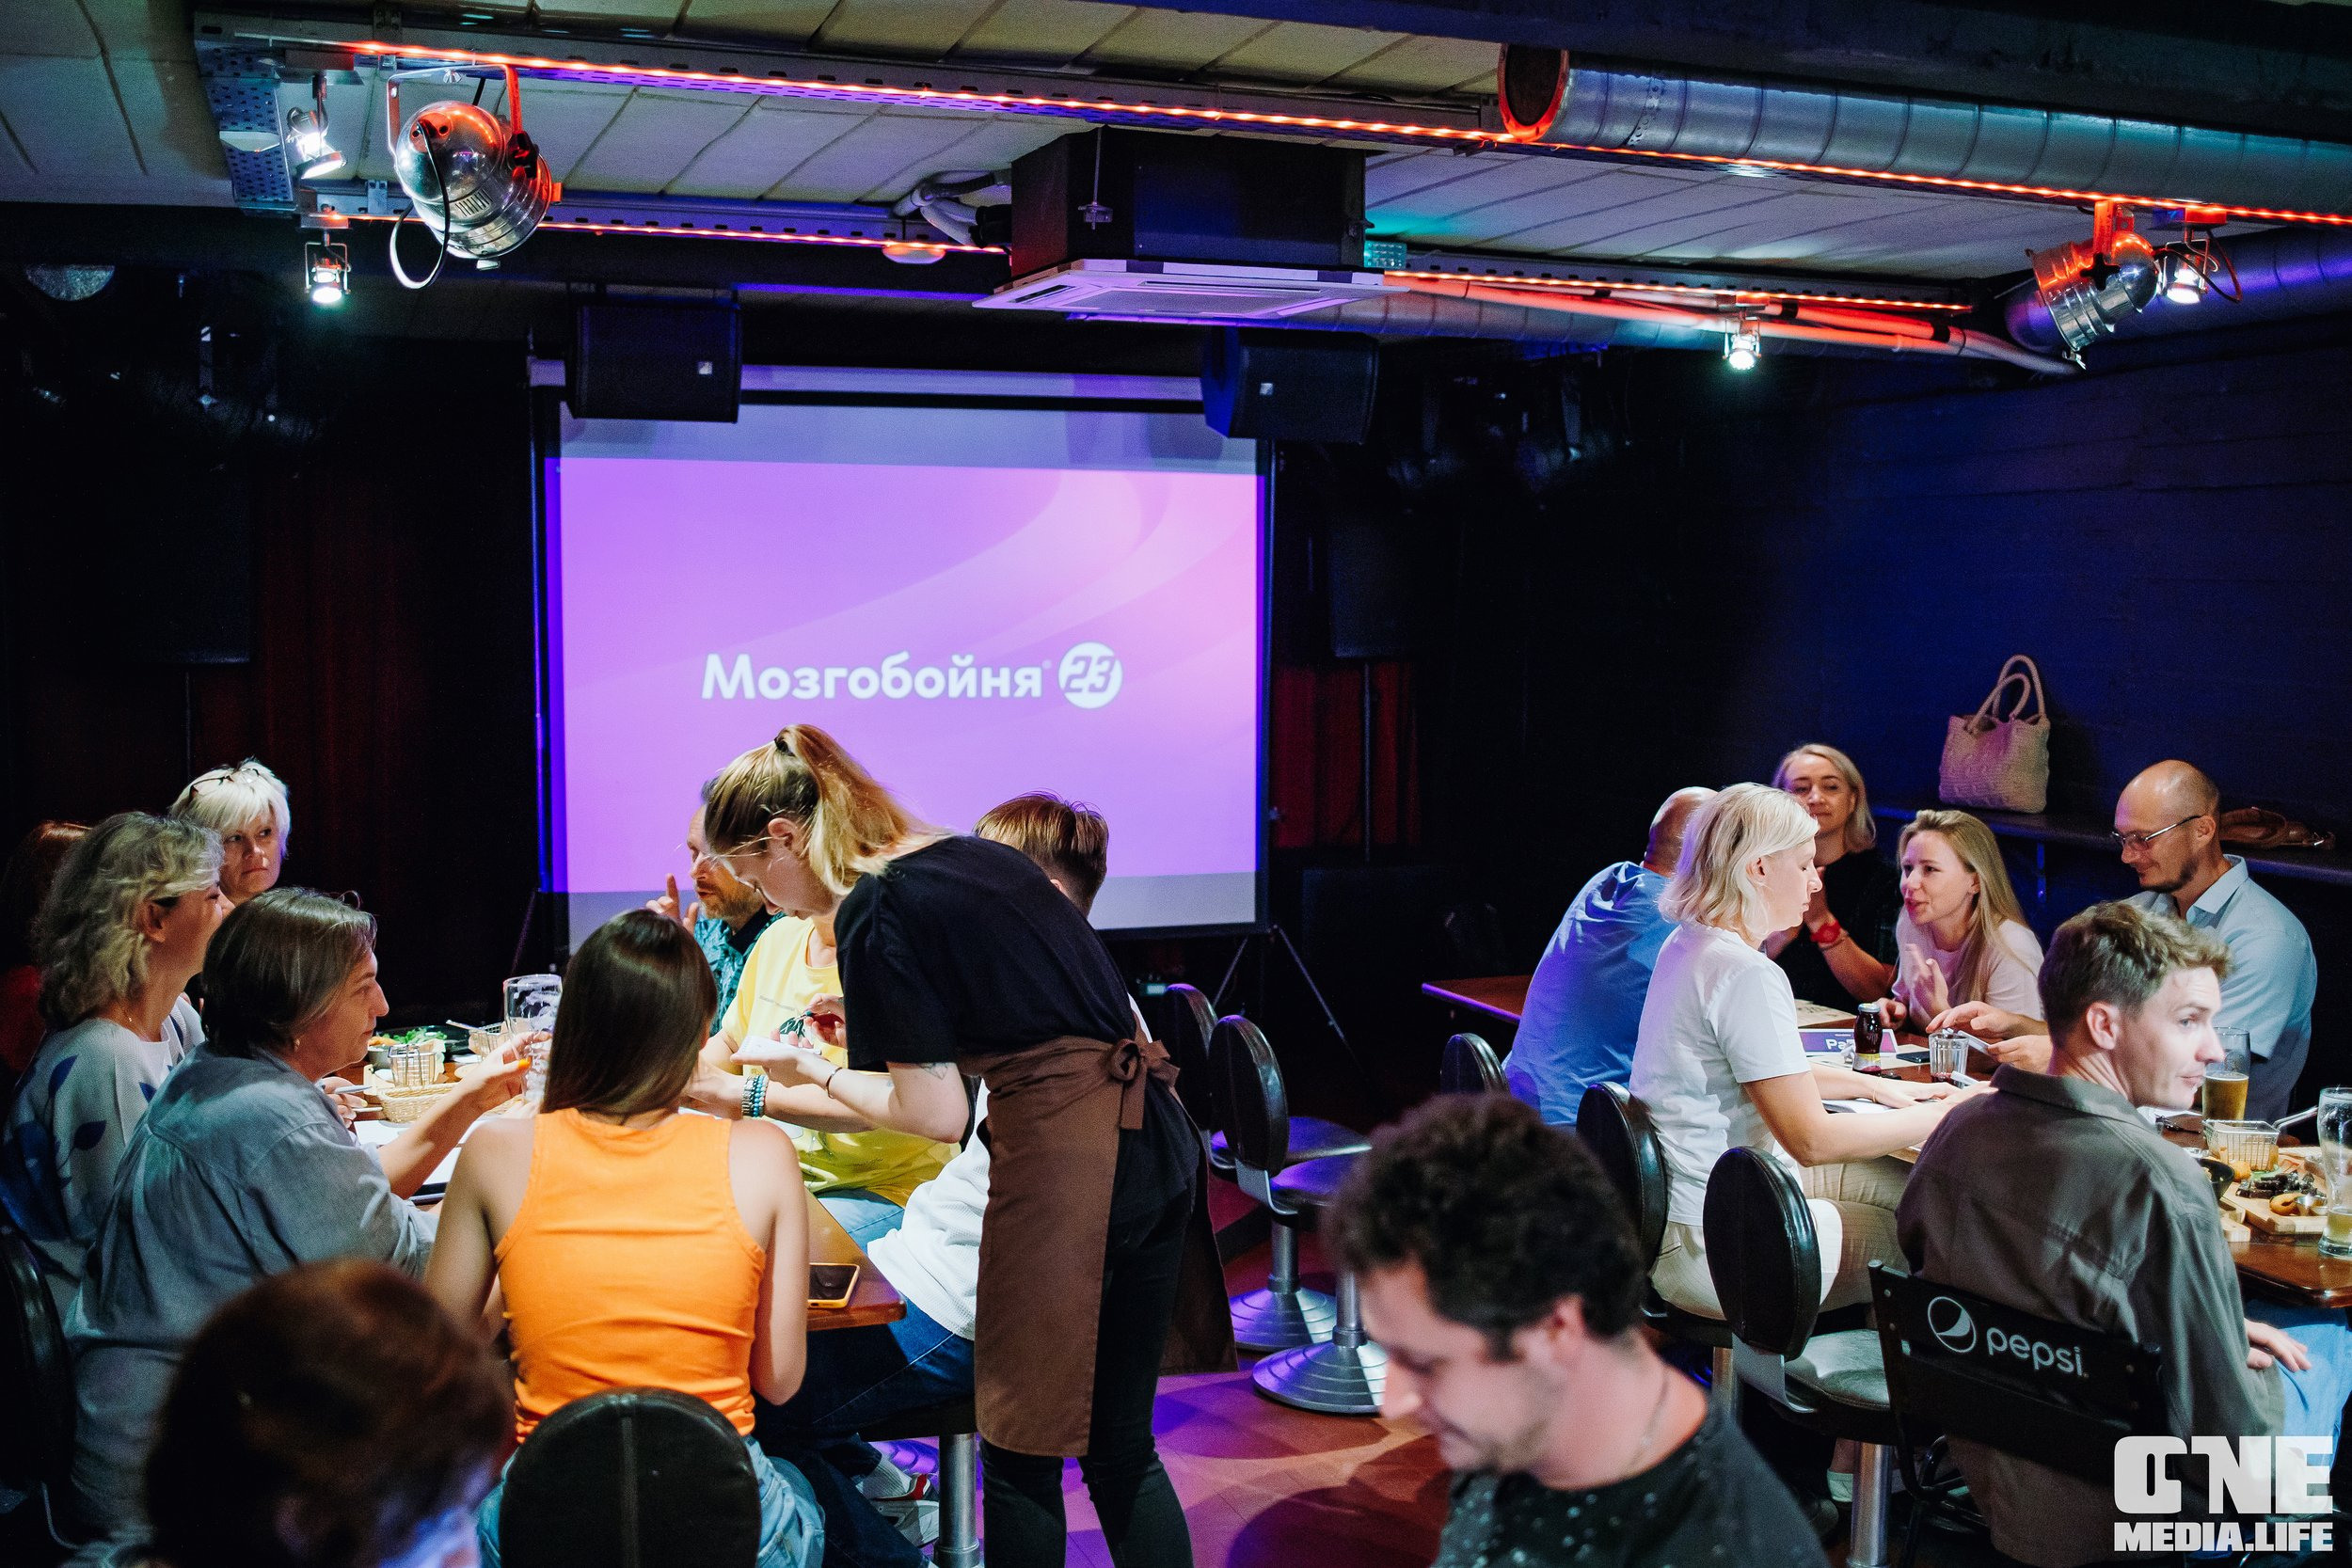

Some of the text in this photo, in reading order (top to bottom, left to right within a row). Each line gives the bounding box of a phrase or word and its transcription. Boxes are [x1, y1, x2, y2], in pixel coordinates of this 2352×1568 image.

[701, 650, 1117, 700] Мозгобойня 23
[1985, 1326, 2084, 1377] pepsi
